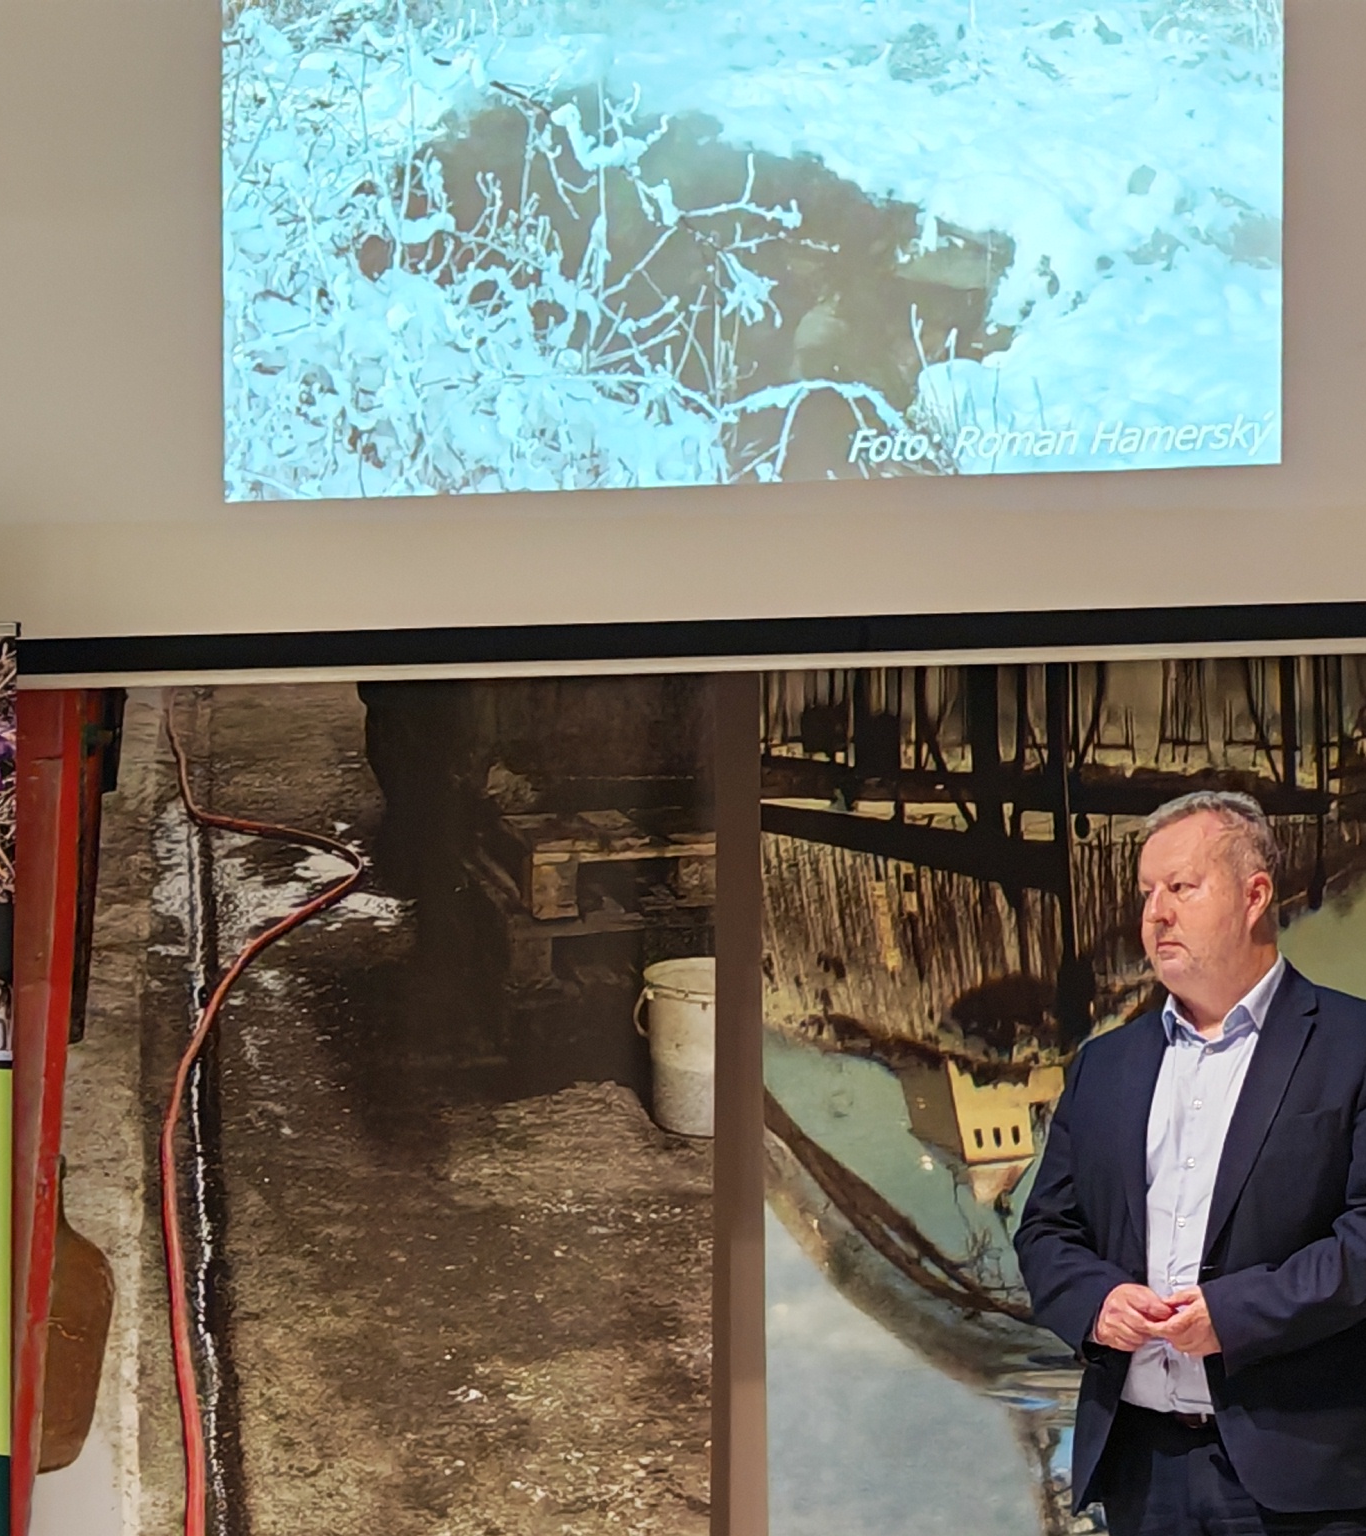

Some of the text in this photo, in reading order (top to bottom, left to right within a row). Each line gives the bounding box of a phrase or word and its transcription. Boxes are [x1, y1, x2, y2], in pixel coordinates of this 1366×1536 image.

[849, 410, 1275, 464] Foto: Roman Hamerský
